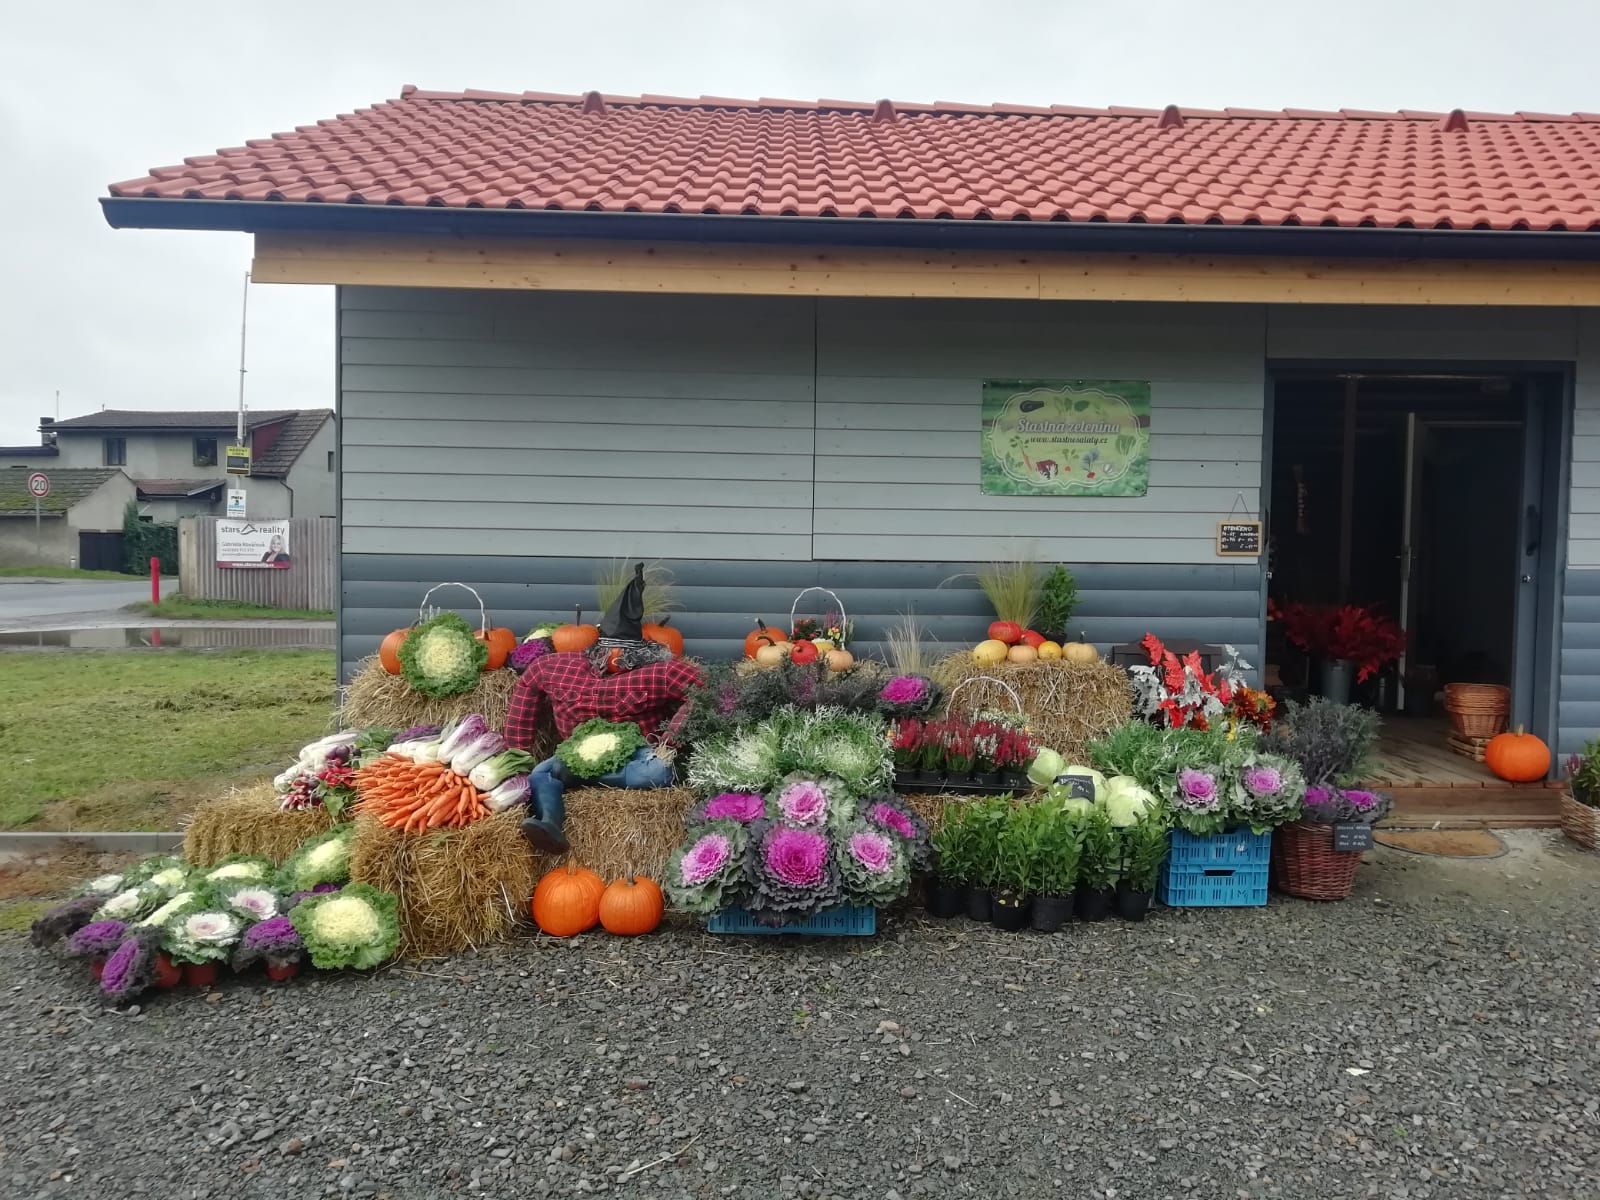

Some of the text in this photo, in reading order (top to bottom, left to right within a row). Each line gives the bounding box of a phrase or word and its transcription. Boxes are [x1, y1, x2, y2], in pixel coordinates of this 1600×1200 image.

[1067, 420, 1120, 433] zelenina
[34, 480, 46, 491] 20
[221, 525, 285, 535] stars reality
